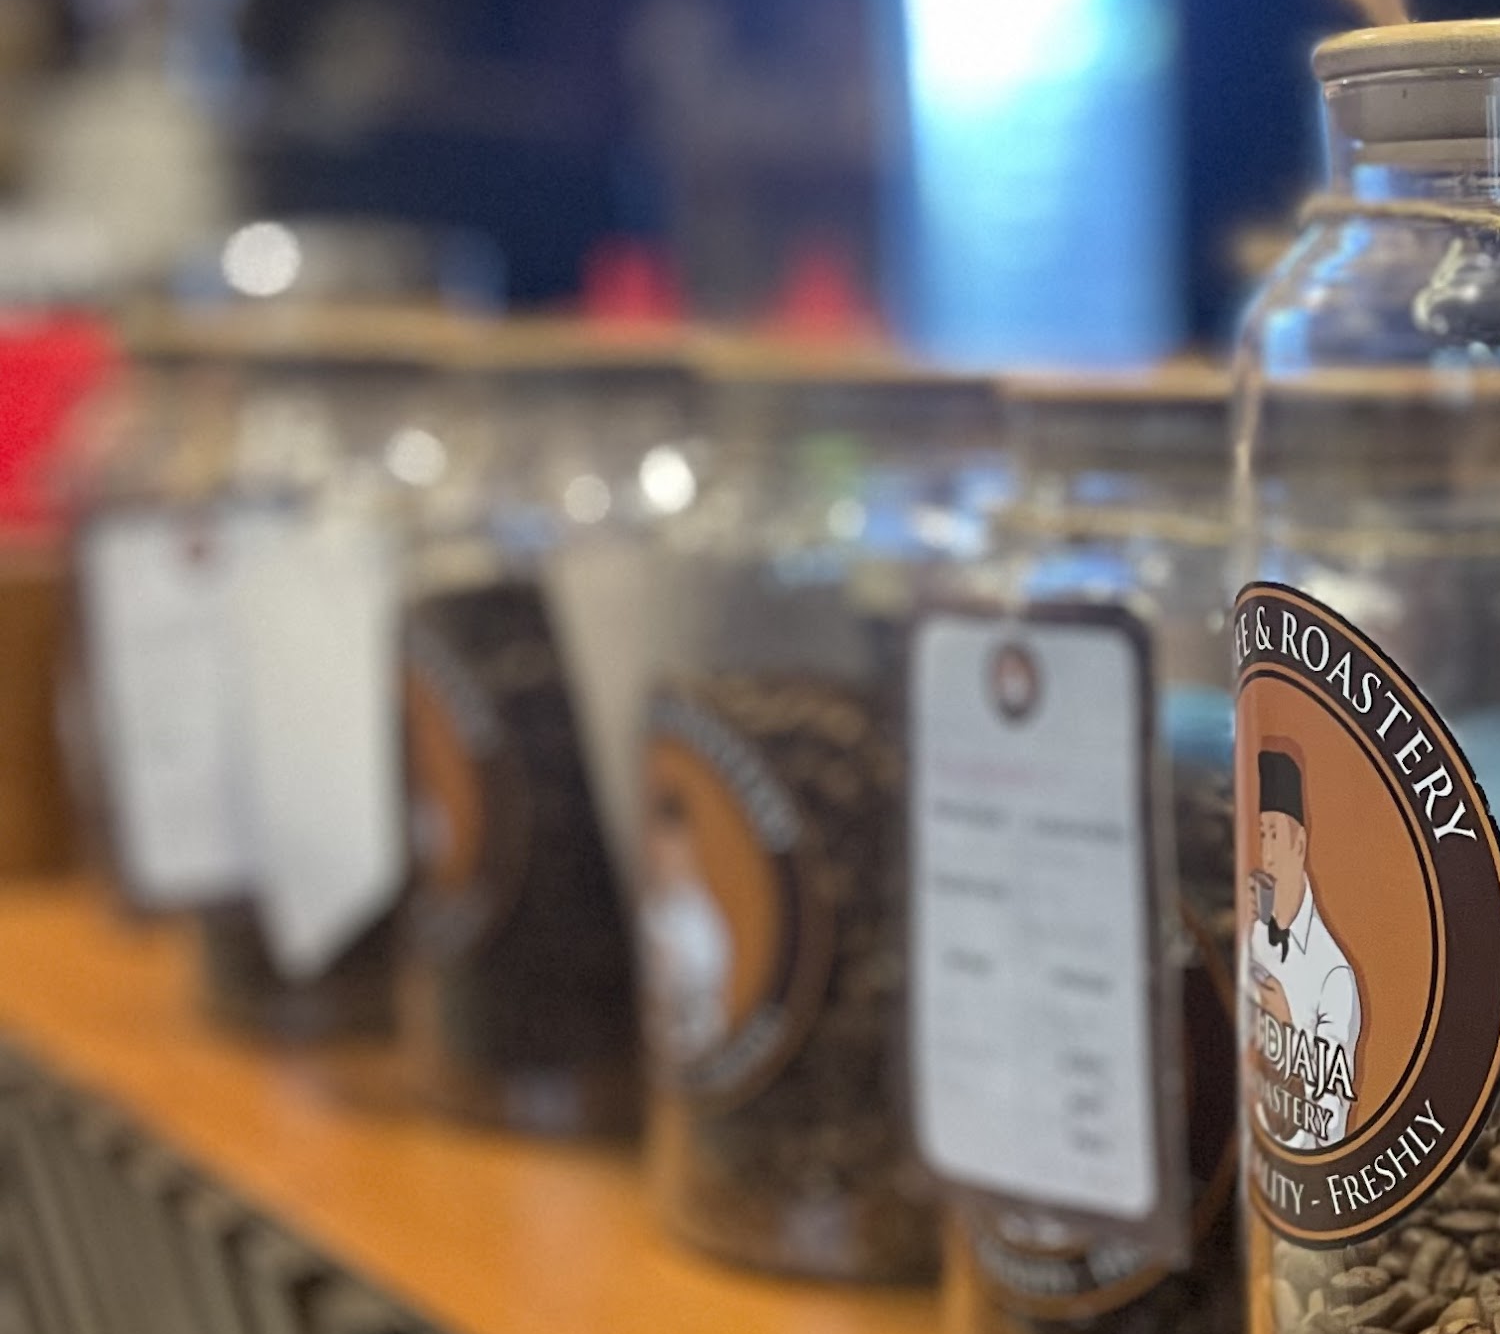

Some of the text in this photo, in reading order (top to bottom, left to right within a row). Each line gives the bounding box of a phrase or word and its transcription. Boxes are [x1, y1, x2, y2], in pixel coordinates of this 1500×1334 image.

[1256, 605, 1477, 843] & ROASTERY
[1326, 1098, 1446, 1216] FRESHLY
